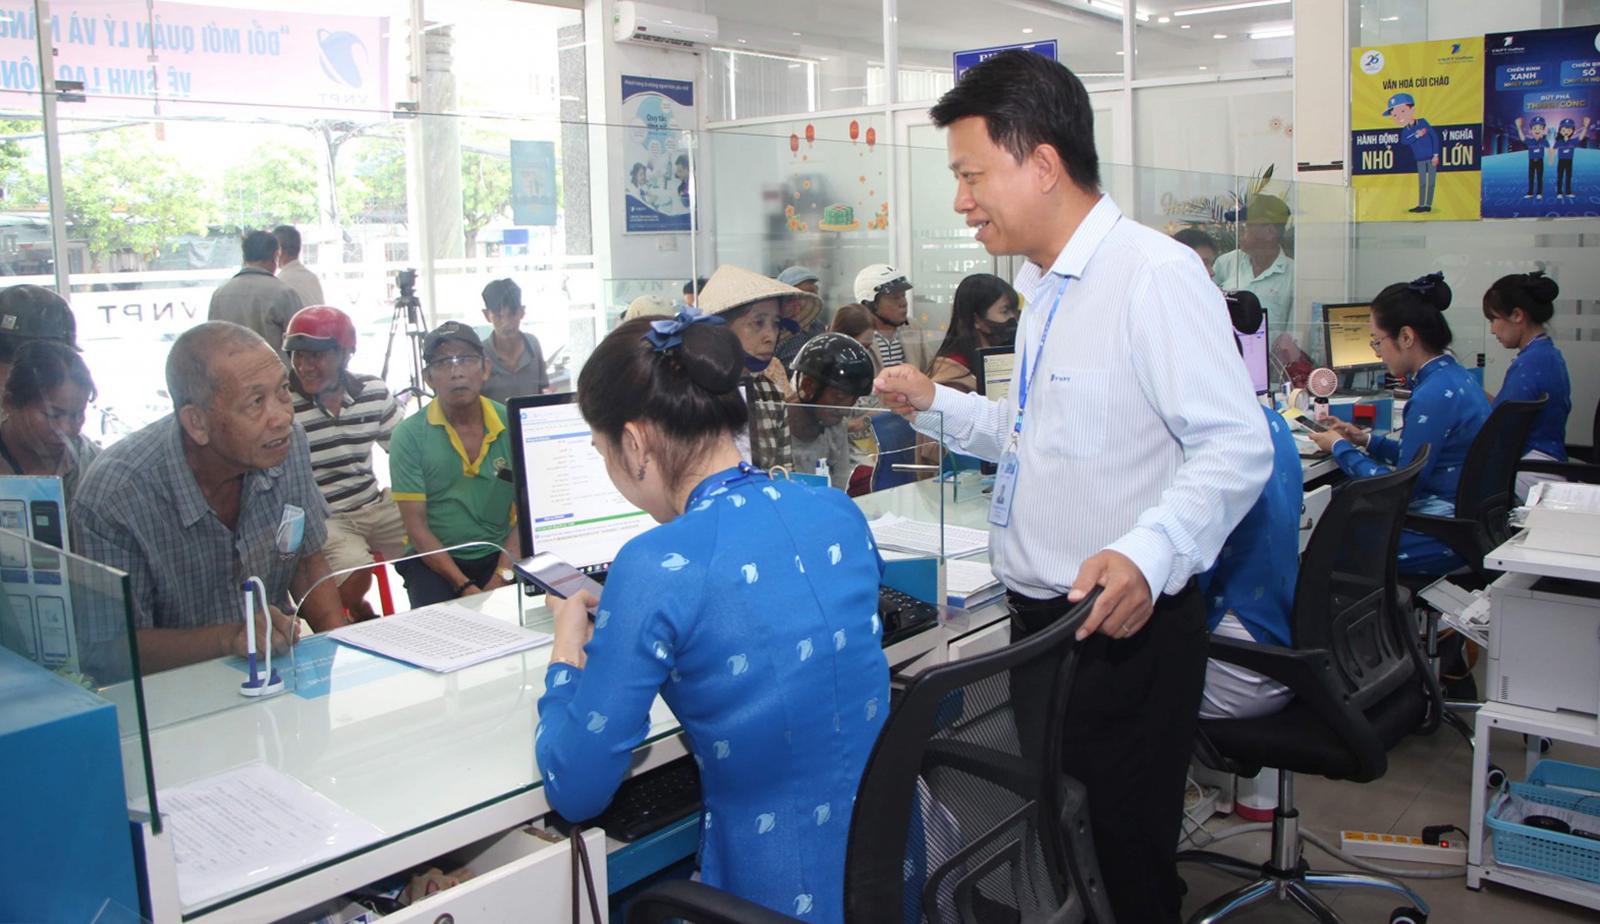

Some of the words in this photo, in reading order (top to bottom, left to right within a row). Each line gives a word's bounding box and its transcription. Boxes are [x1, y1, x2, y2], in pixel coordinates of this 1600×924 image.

[1510, 72, 1537, 81] XANH
[1582, 68, 1596, 77] SỐ
[1383, 78, 1398, 90] VĂN
[1356, 133, 1378, 145] HÀNH
[1378, 132, 1399, 146] ĐỘNG
[1442, 128, 1448, 141] Ý
[1449, 127, 1474, 141] NGHĨA
[1361, 145, 1394, 170] NHỎ
[1442, 142, 1474, 167] LỚN
